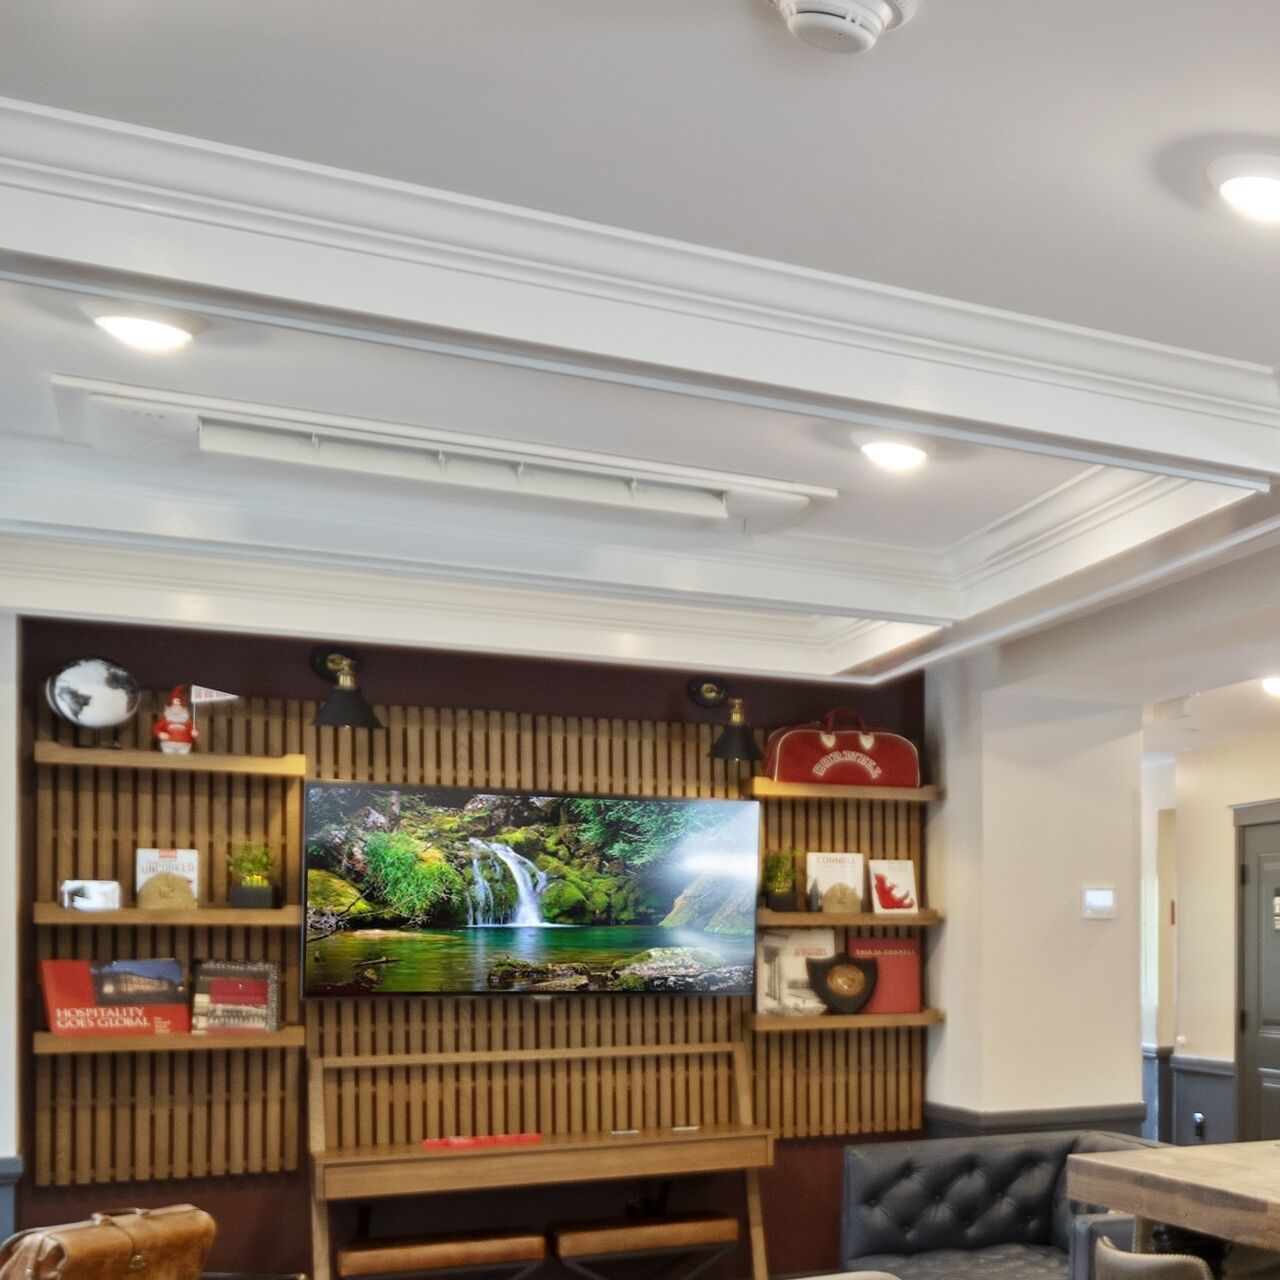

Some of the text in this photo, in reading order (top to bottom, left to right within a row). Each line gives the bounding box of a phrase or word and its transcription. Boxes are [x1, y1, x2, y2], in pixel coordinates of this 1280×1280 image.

[812, 750, 882, 779] CORNELL
[56, 1006, 145, 1018] HOSPITALITY
[56, 1016, 96, 1028] GOES
[99, 1016, 149, 1028] GLOBAL
